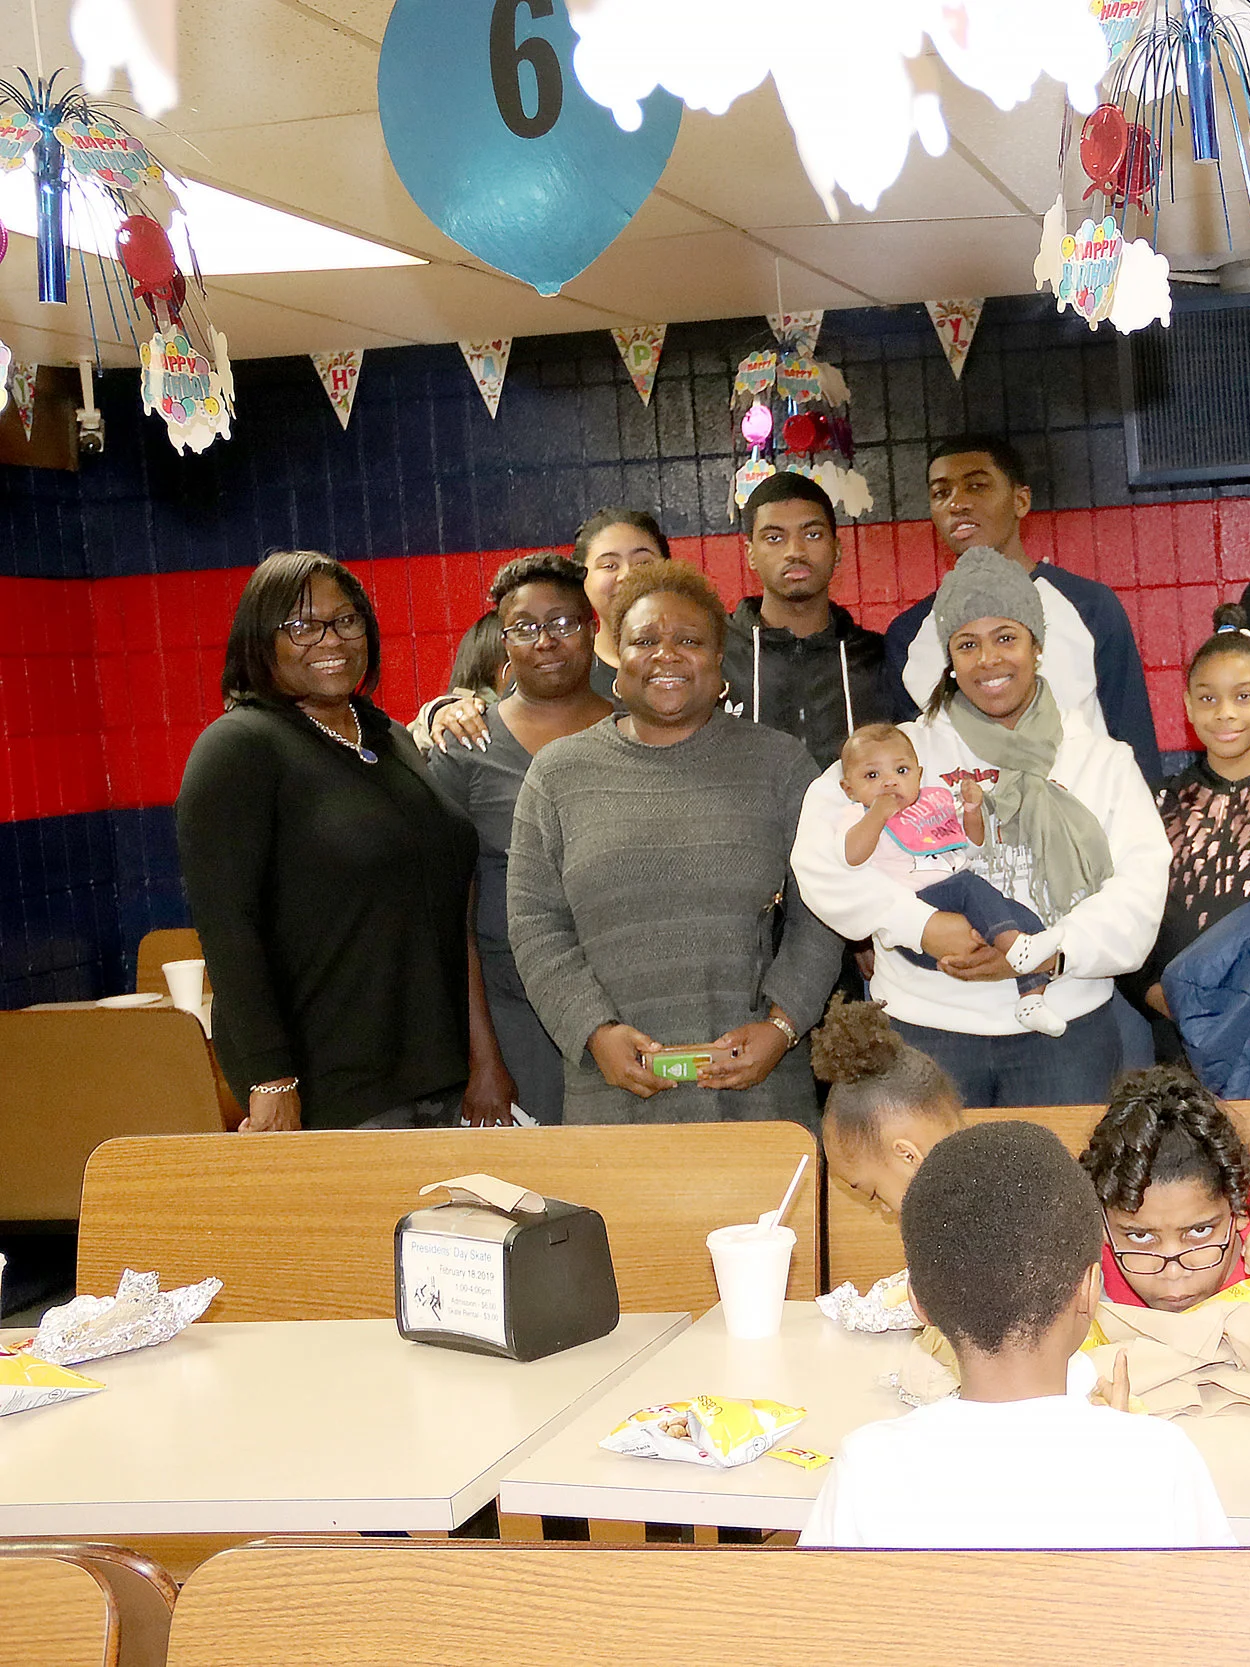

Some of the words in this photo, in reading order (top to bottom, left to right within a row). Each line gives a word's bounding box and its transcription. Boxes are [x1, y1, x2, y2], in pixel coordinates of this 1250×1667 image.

[490, 0, 563, 139] 6
[72, 135, 129, 151] HAPPY
[1075, 239, 1117, 260] HAPPY
[331, 368, 348, 391] H
[633, 349, 651, 367] P
[949, 317, 963, 343] Y
[470, 1249, 492, 1262] Skate
